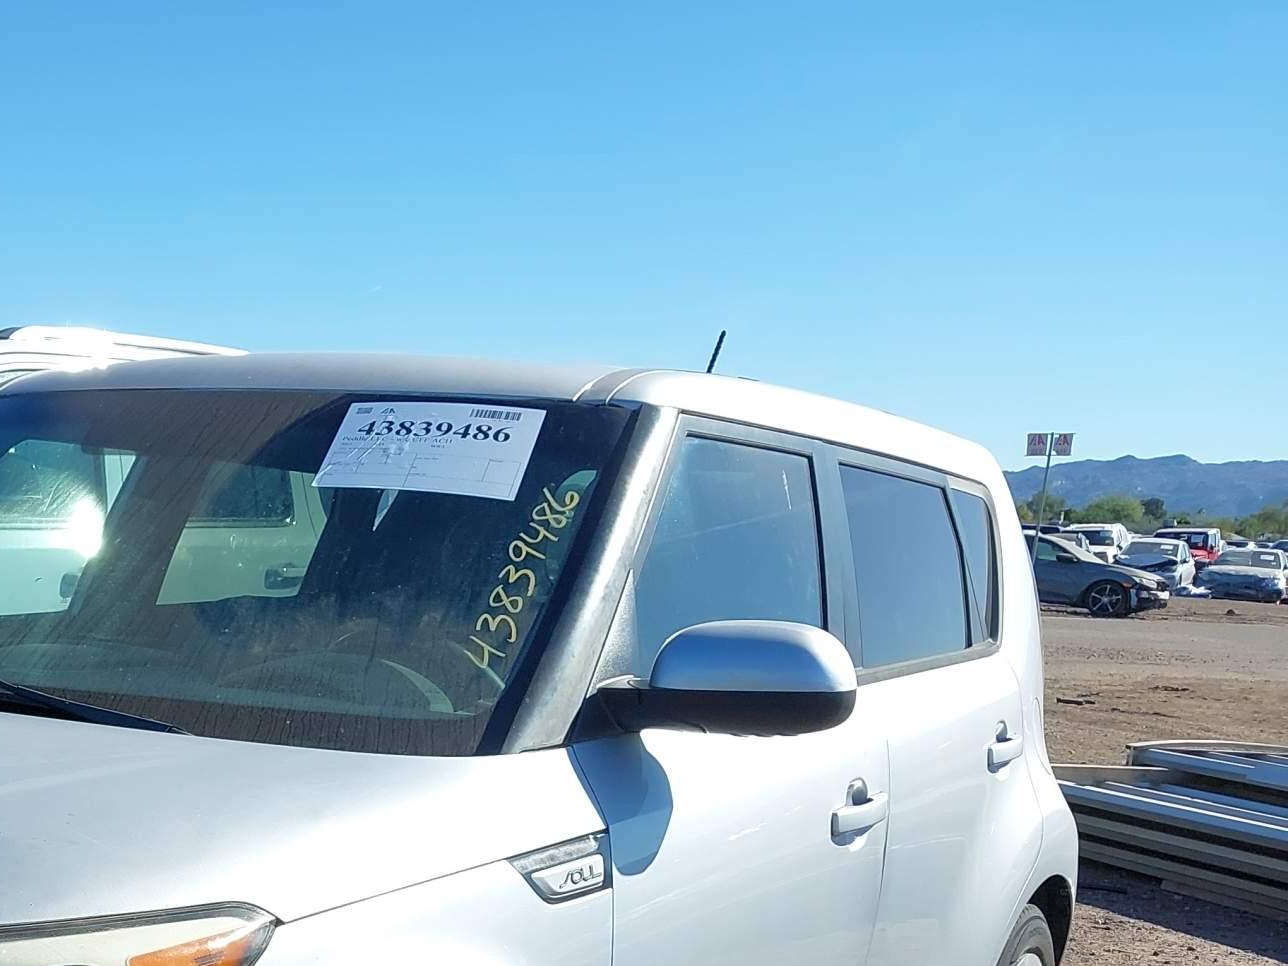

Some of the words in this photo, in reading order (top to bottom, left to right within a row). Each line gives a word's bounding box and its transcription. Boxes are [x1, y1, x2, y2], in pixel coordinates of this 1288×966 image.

[357, 420, 513, 443] 43839486
[463, 487, 580, 669] 43839486
[558, 865, 603, 889] SOUL
